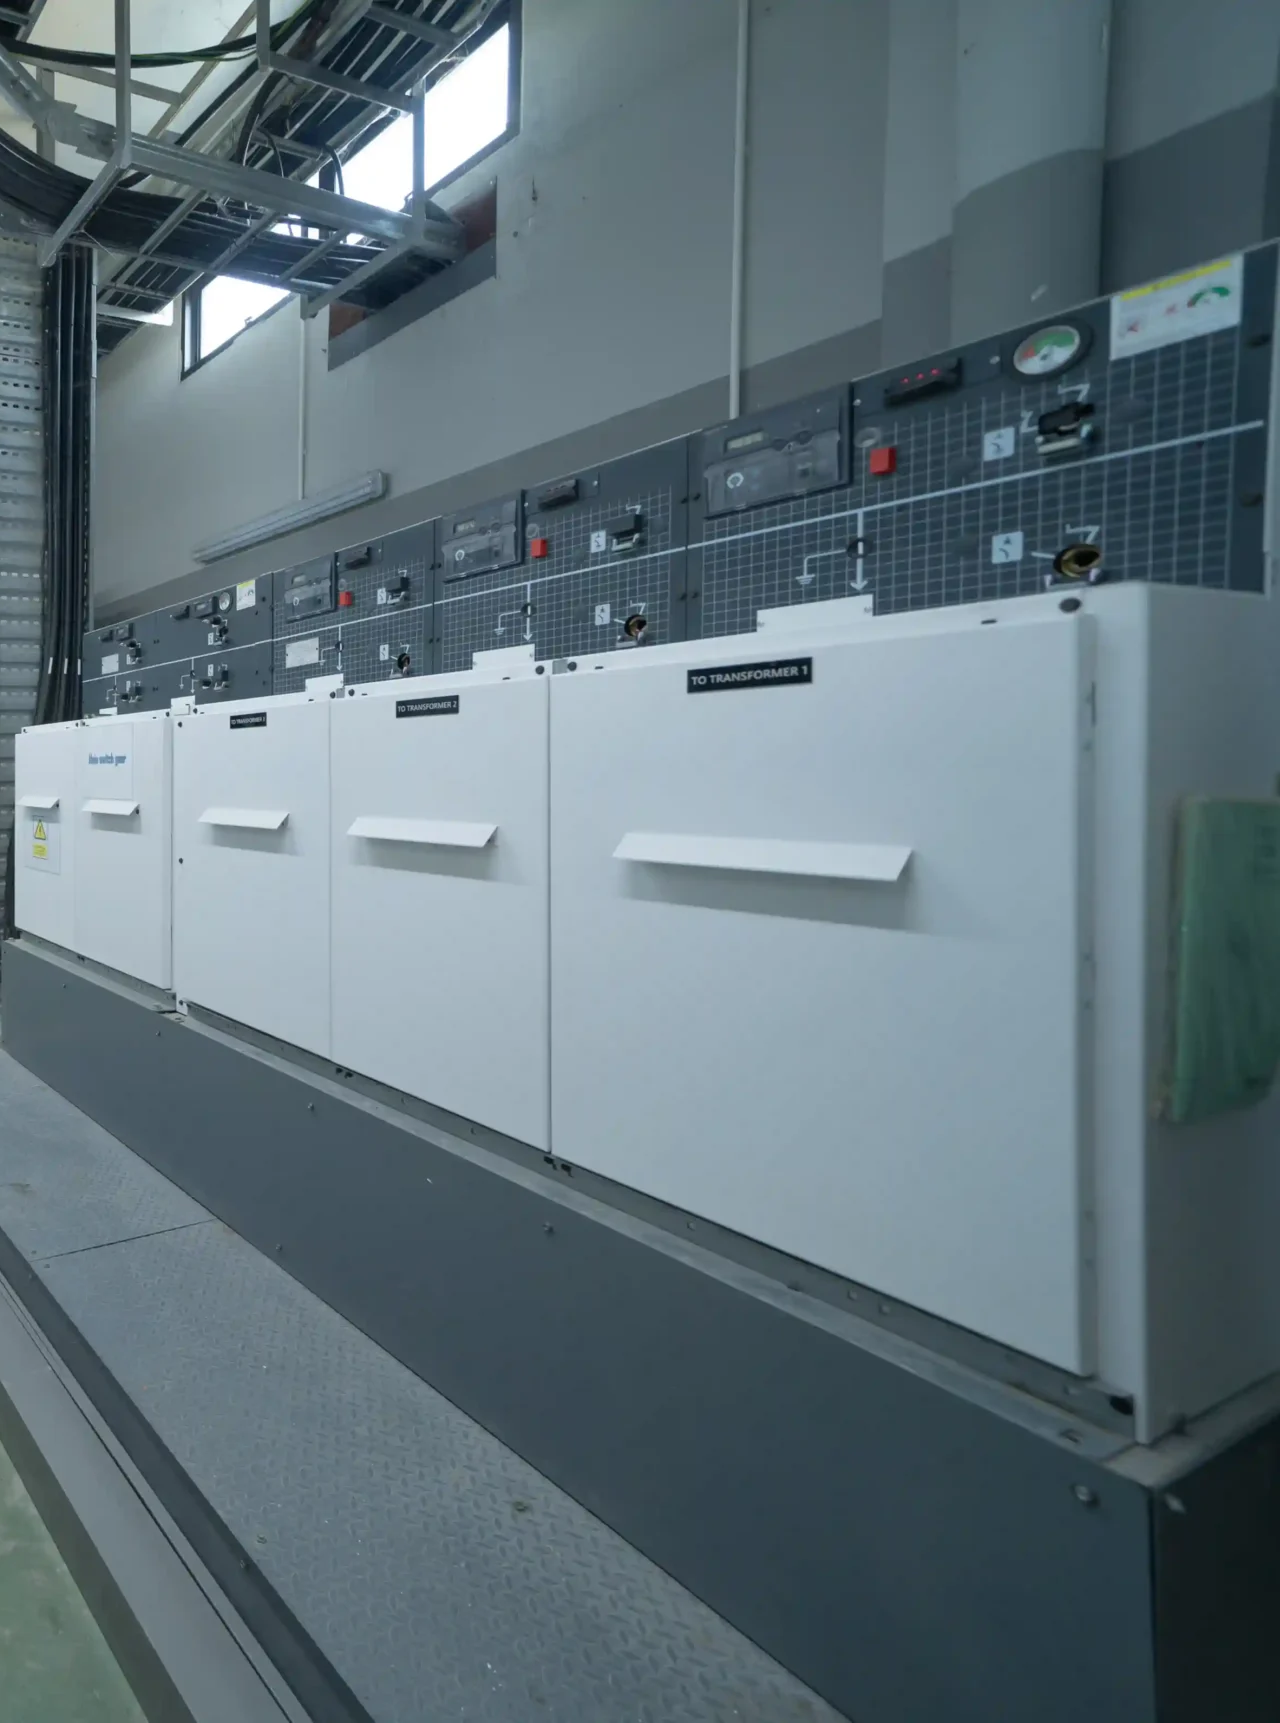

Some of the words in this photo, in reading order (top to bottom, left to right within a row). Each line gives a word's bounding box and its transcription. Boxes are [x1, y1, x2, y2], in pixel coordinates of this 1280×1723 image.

[691, 675, 707, 685] TO
[709, 666, 799, 684] TRANSFORMER
[801, 665, 808, 675] 1
[407, 702, 451, 711] TRANSFORMER
